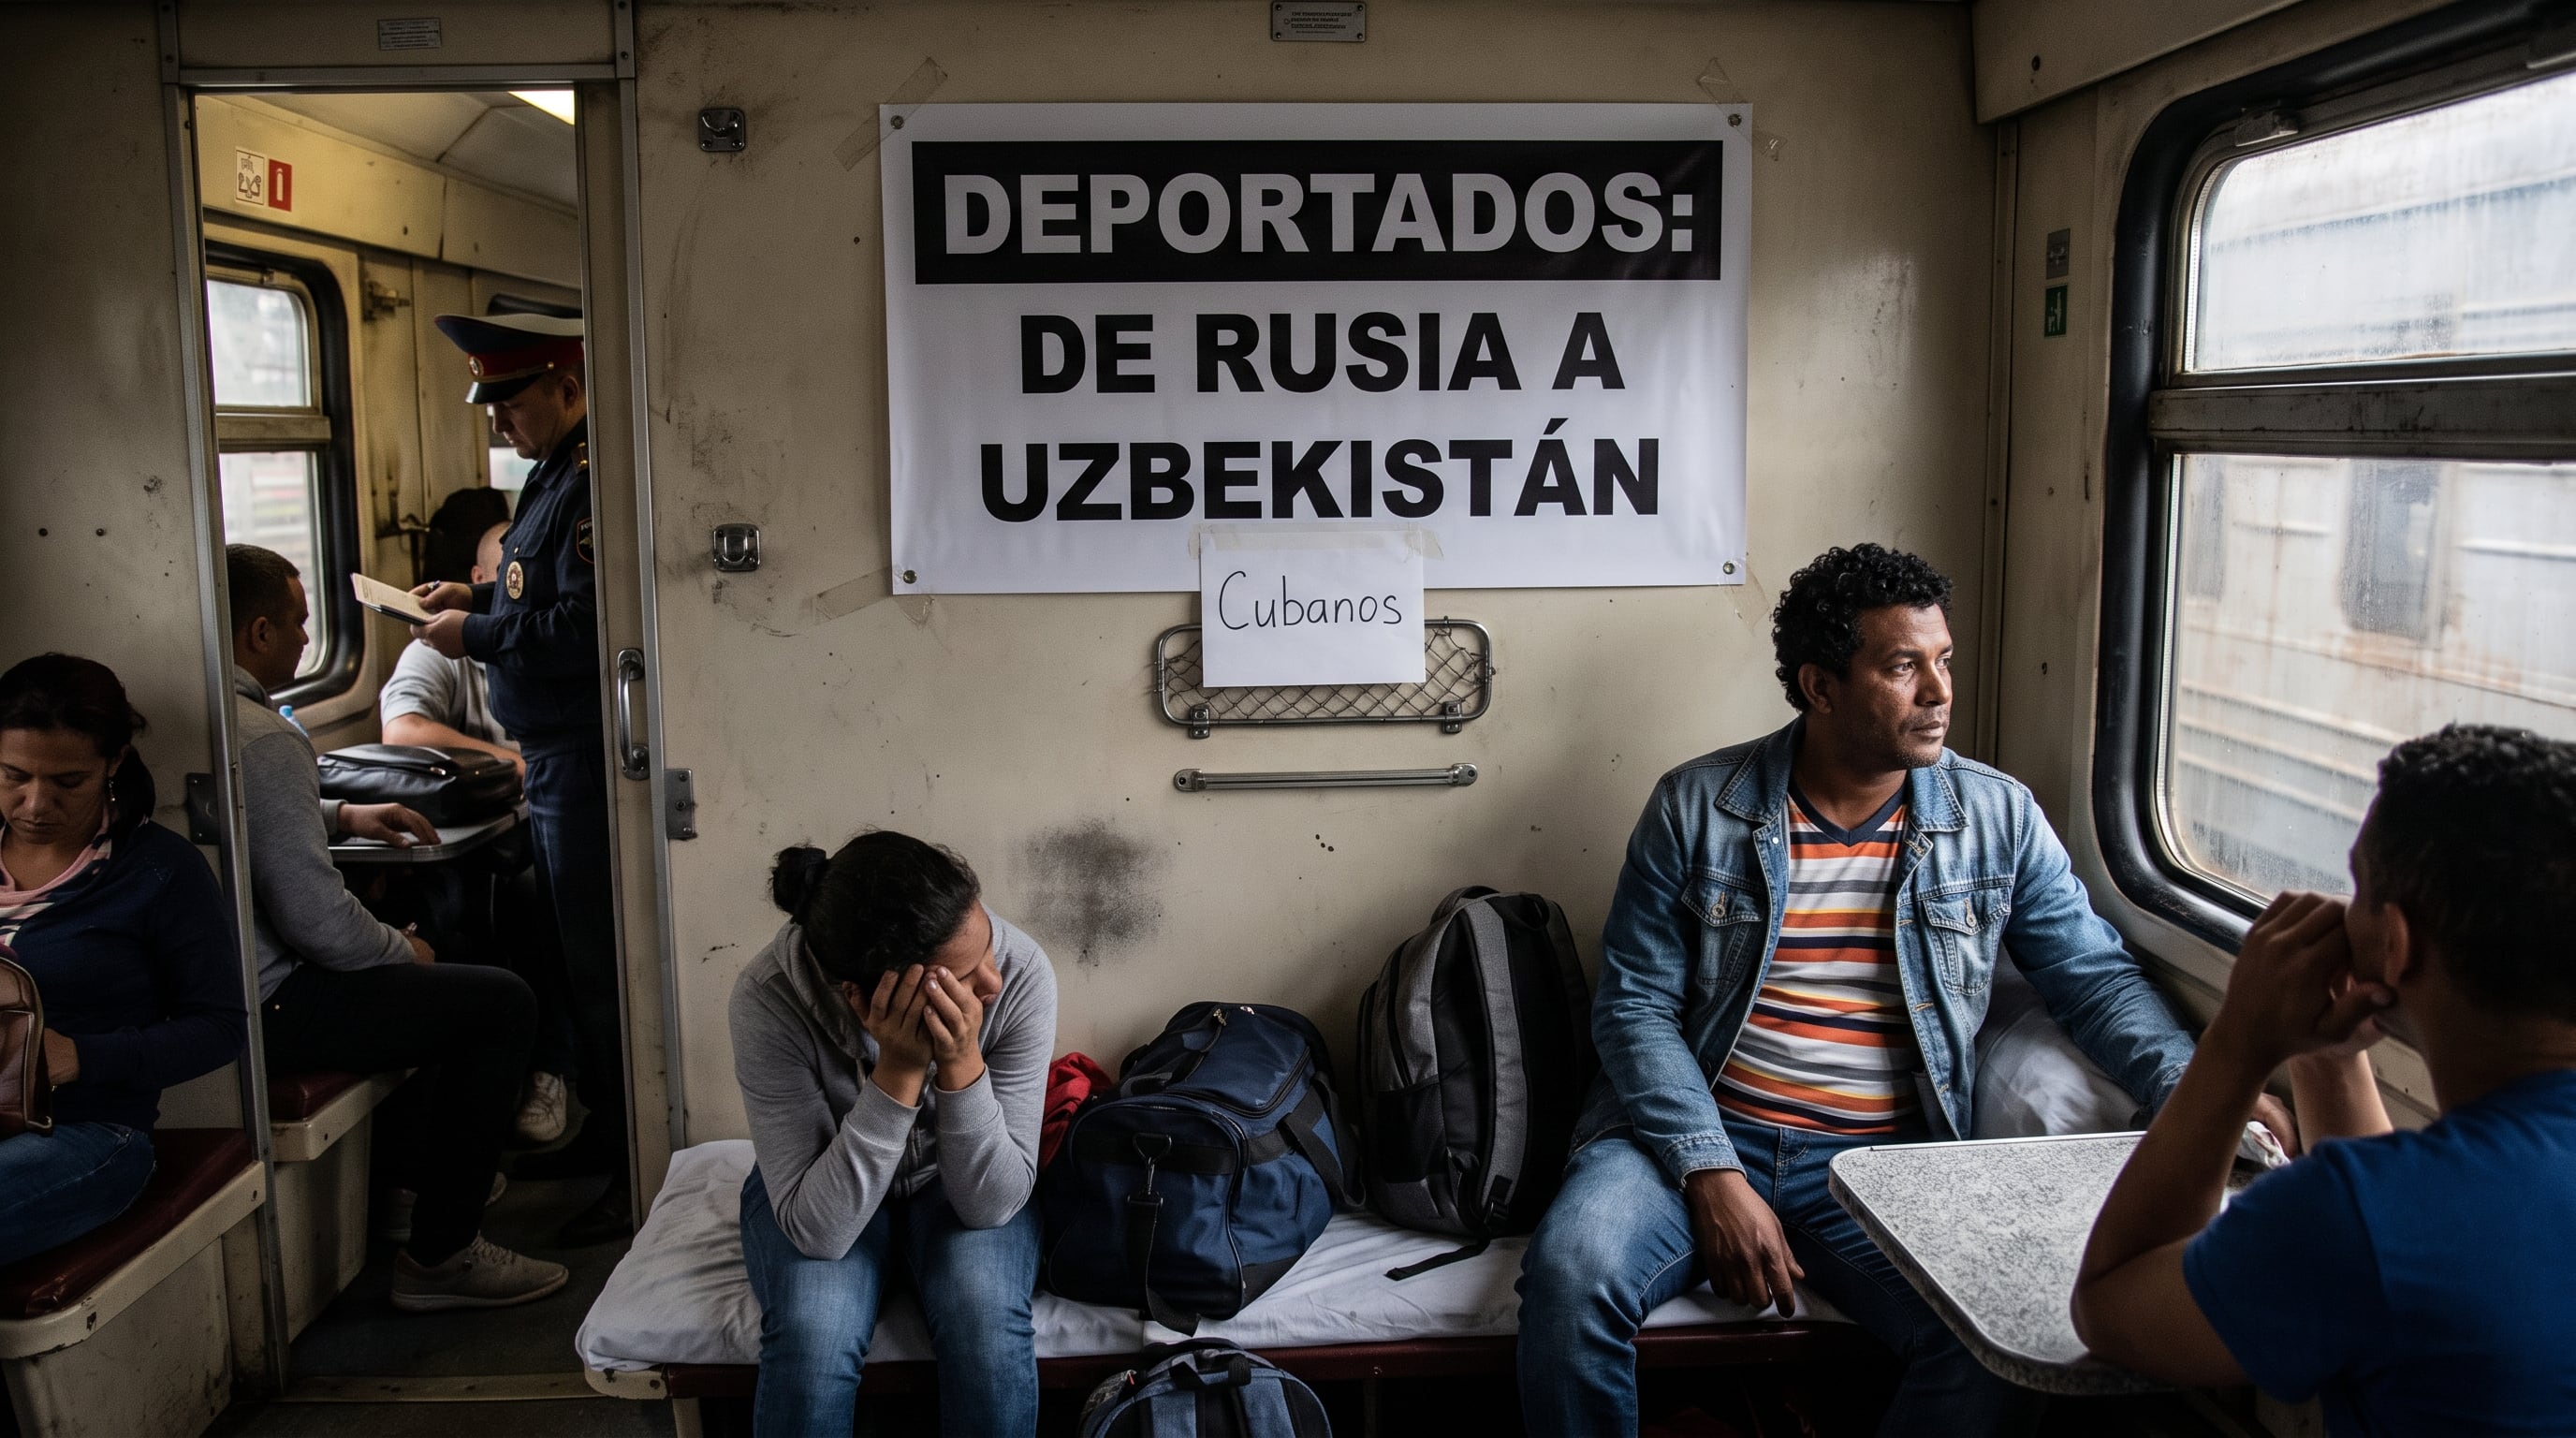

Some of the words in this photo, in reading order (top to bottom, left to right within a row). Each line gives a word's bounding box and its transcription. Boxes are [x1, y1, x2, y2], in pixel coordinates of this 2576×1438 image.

[945, 171, 1692, 255] DEPORTADOS:
[1021, 315, 1155, 393] DE
[1196, 312, 1521, 392] RUSIA
[1552, 312, 1626, 390] A
[980, 418, 1659, 522] UZBEKISTÁN
[1219, 570, 1402, 631] Cubanos
